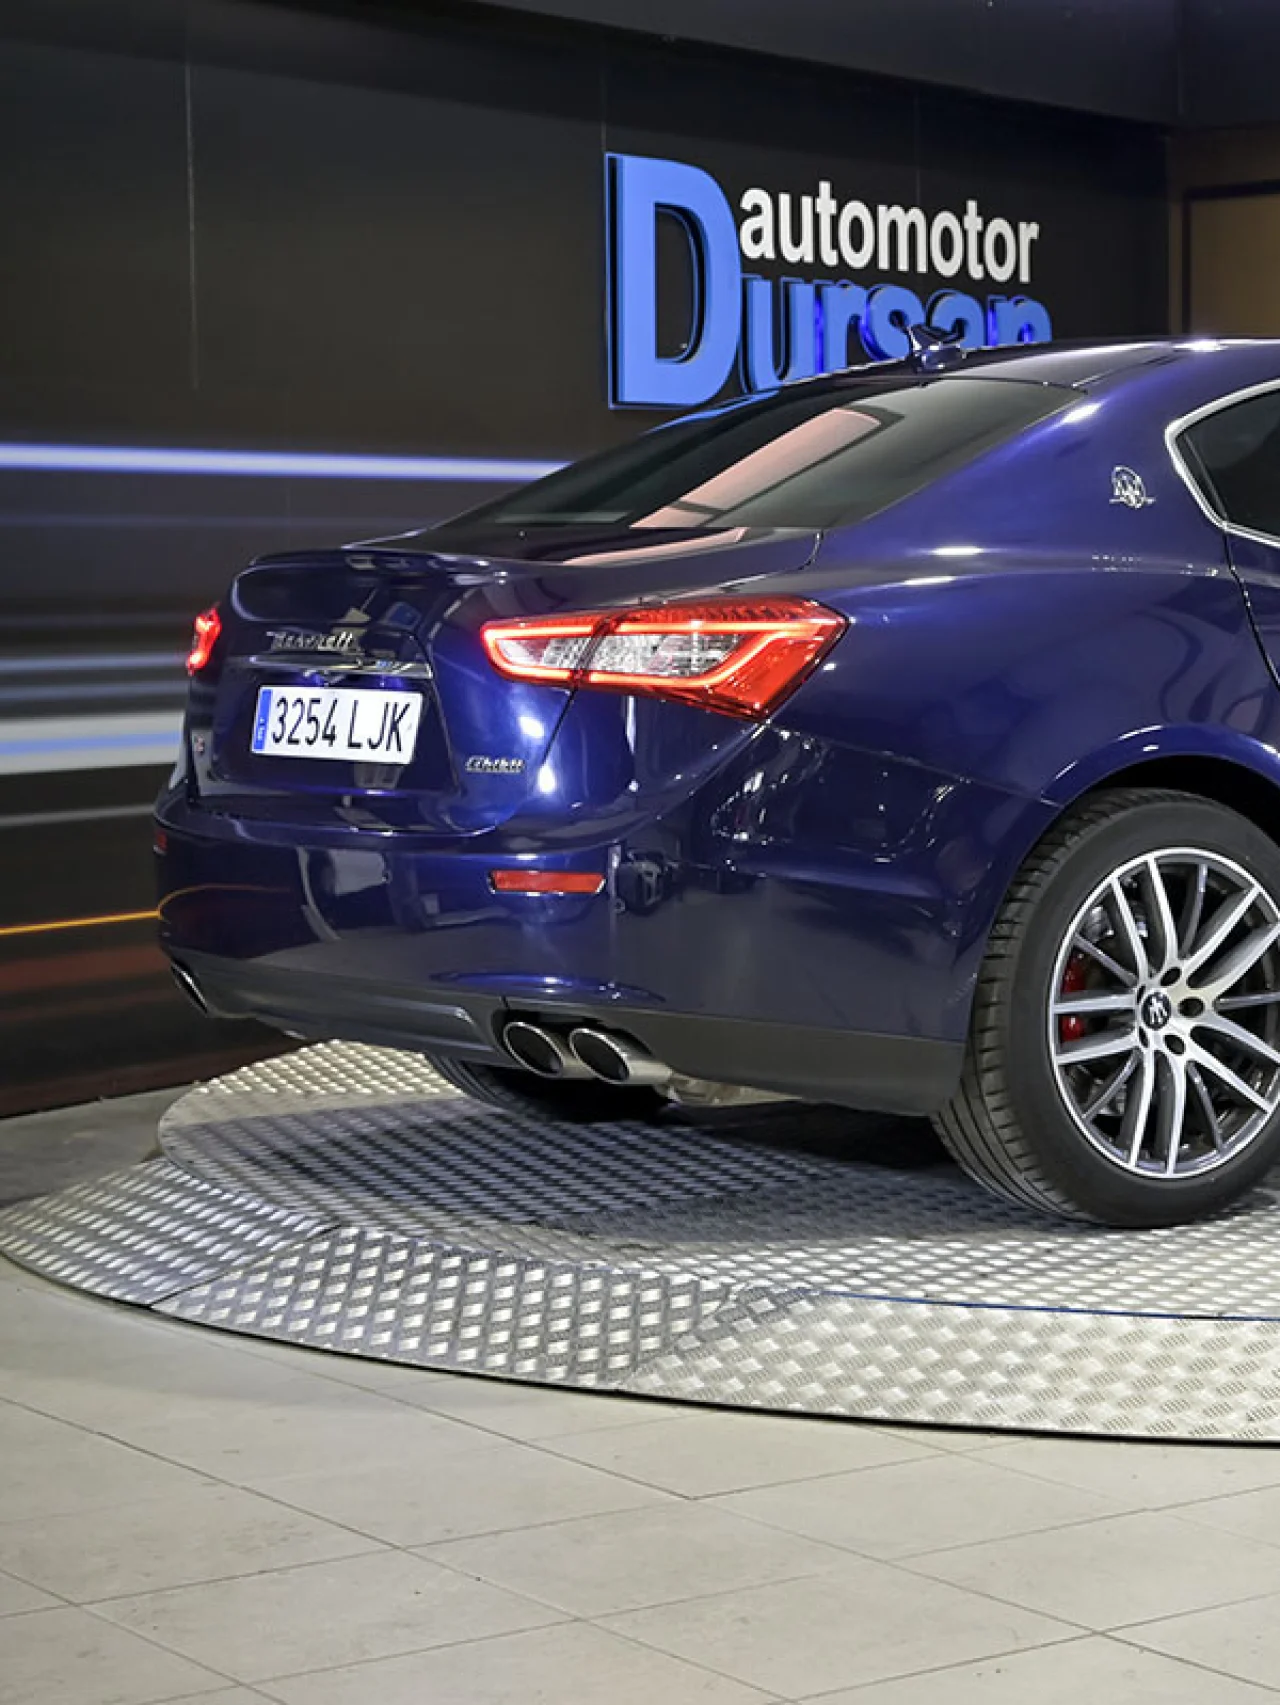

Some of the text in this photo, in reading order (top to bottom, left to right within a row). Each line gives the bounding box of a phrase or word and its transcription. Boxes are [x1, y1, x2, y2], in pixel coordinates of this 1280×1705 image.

[740, 180, 1040, 284] automotor
[271, 696, 338, 747] 3254
[347, 699, 411, 752] LJK
